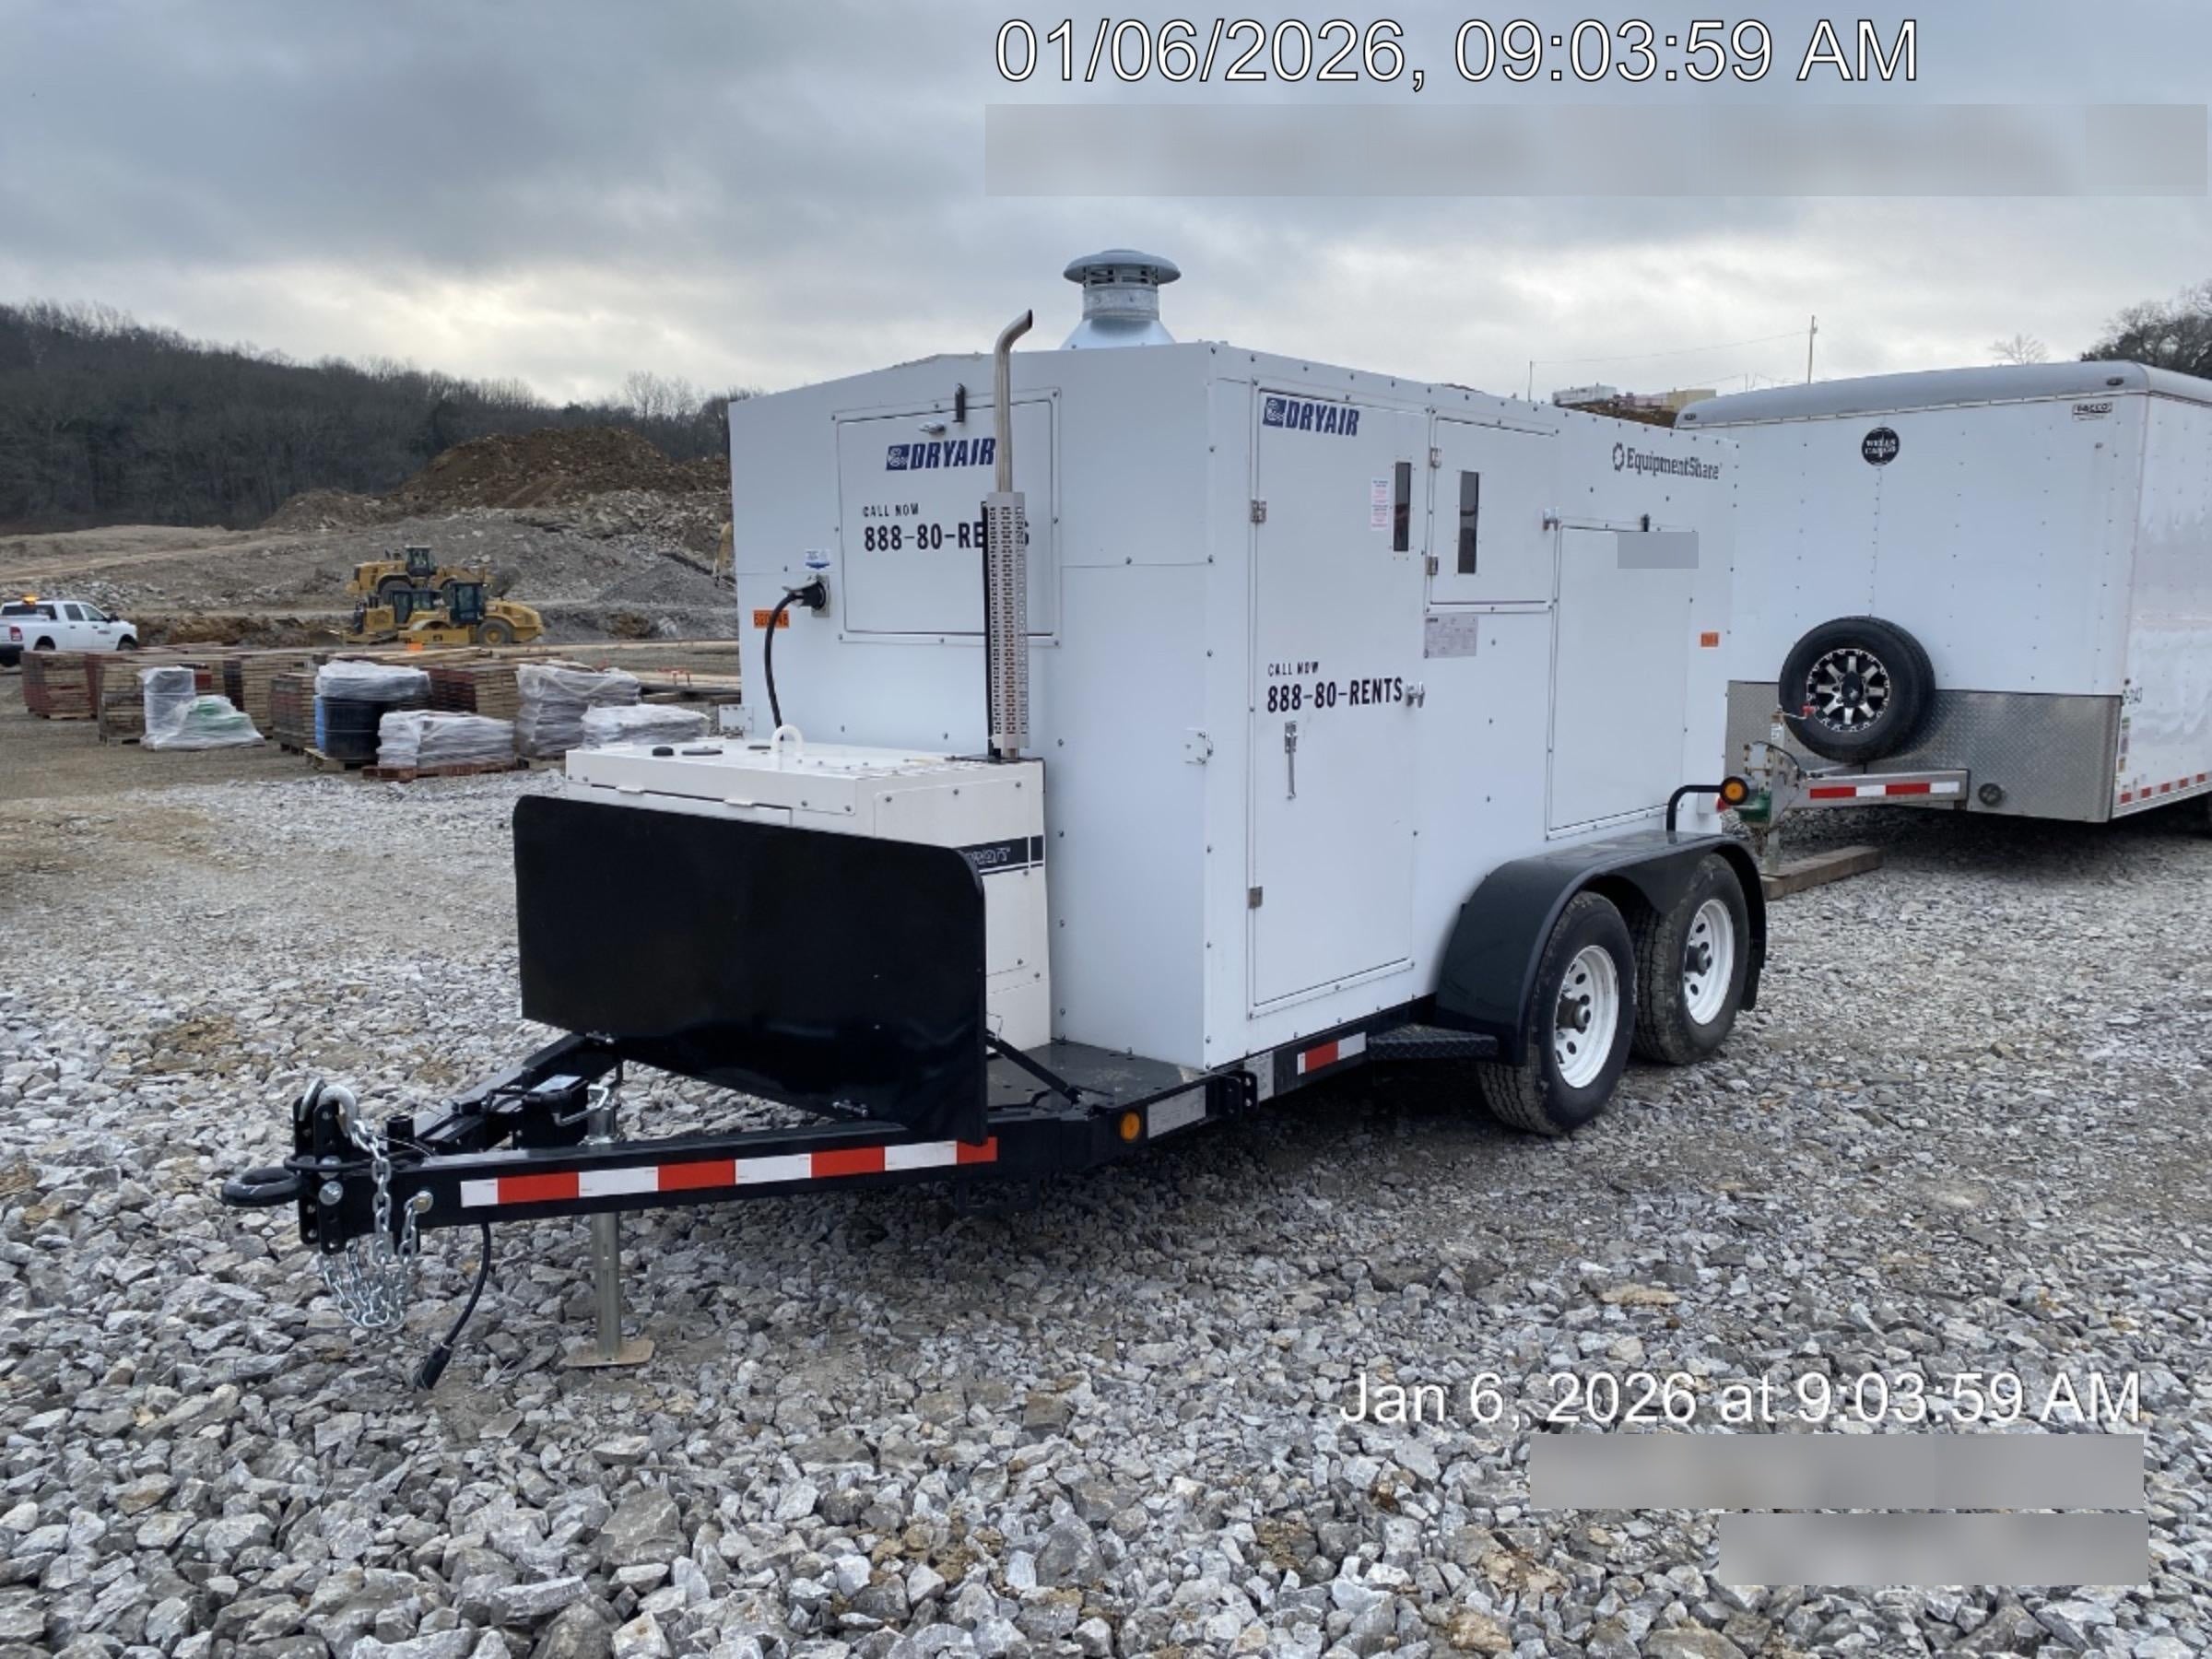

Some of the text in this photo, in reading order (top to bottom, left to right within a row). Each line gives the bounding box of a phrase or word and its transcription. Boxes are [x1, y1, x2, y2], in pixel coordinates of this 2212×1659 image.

[1286, 400, 1359, 436] DRYAIR
[911, 438, 995, 469] DRYAIR
[1627, 448, 1719, 479] EquipmentShare
[863, 503, 919, 517] CALL NOW
[1267, 661, 1319, 676] CALL NOW
[1267, 677, 1403, 712] 888-80-RENTS
